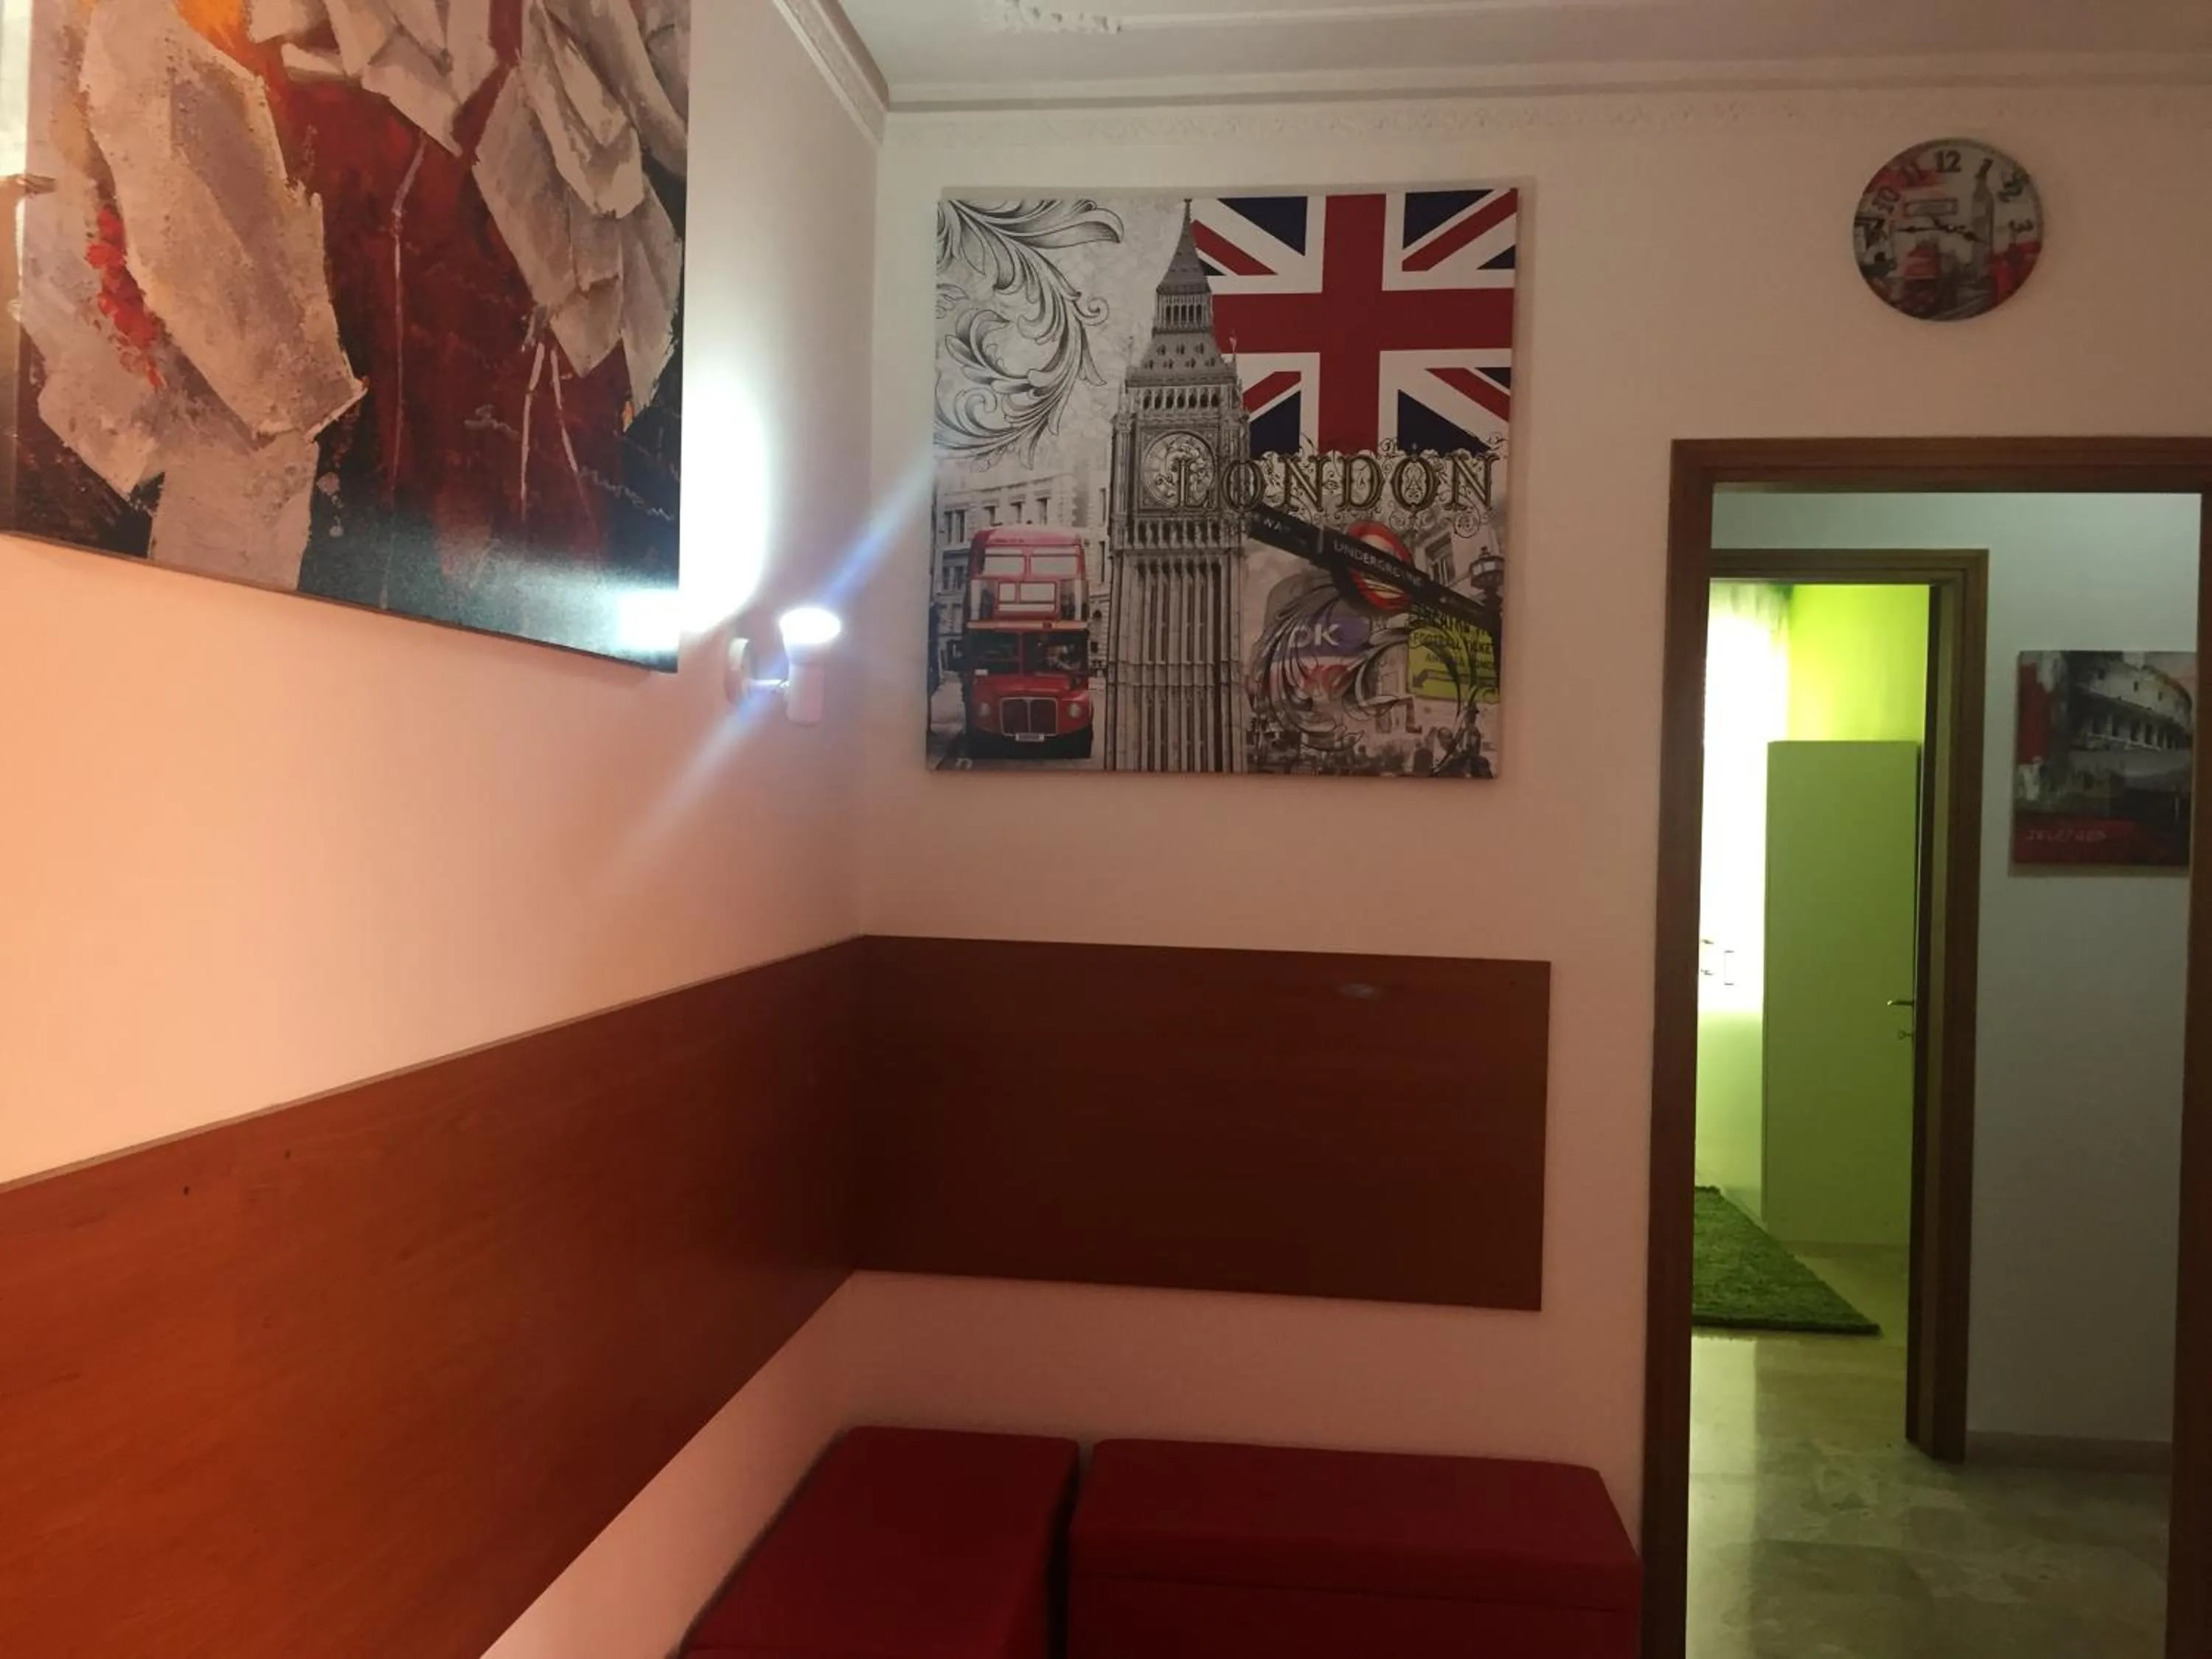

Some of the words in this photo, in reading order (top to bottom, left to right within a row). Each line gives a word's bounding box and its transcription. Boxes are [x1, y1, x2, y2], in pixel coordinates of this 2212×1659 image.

[1935, 150, 1961, 173] 12
[1872, 186, 1900, 215] 10
[1171, 451, 1500, 515] LONDON
[1333, 540, 1423, 587] UNDERGROND
